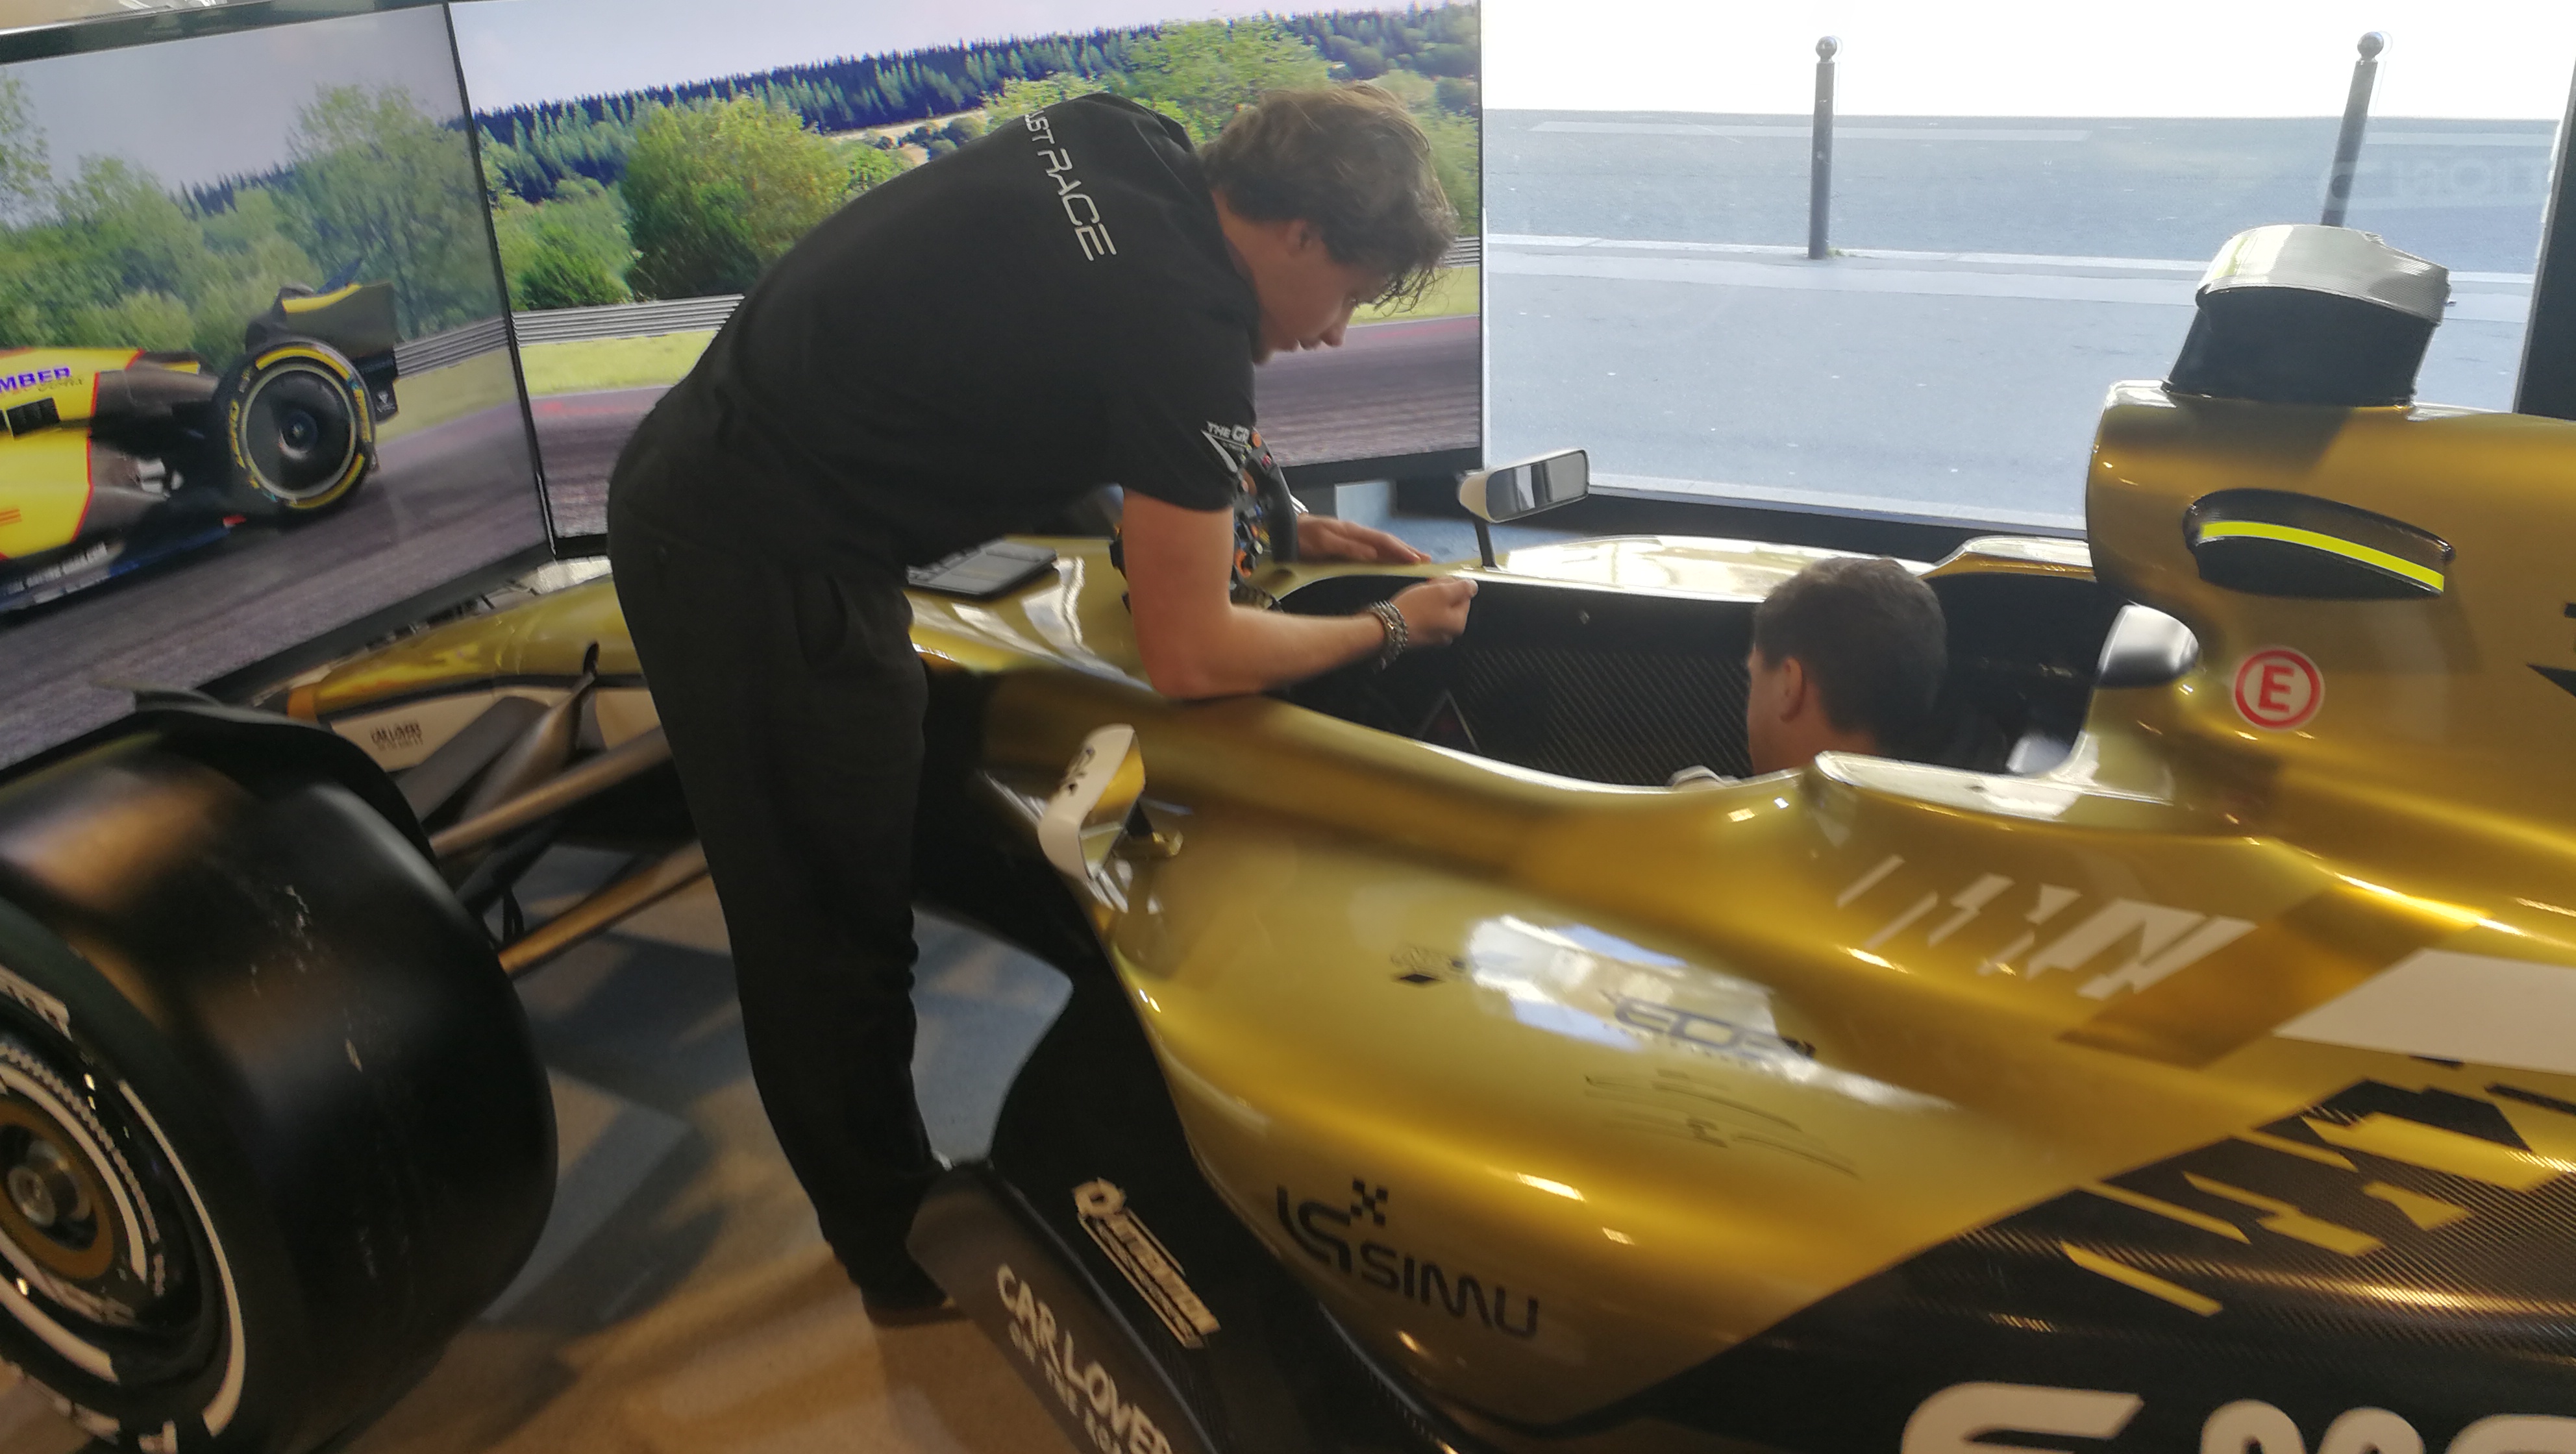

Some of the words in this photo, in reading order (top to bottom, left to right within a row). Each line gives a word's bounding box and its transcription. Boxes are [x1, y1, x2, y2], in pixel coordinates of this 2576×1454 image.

[1024, 110, 1055, 144] UST
[1037, 148, 1117, 261] RACE
[1206, 420, 1231, 439] THE
[2259, 665, 2294, 712] E
[997, 1263, 1062, 1375] CAR
[1360, 1240, 1539, 1338] SIMU
